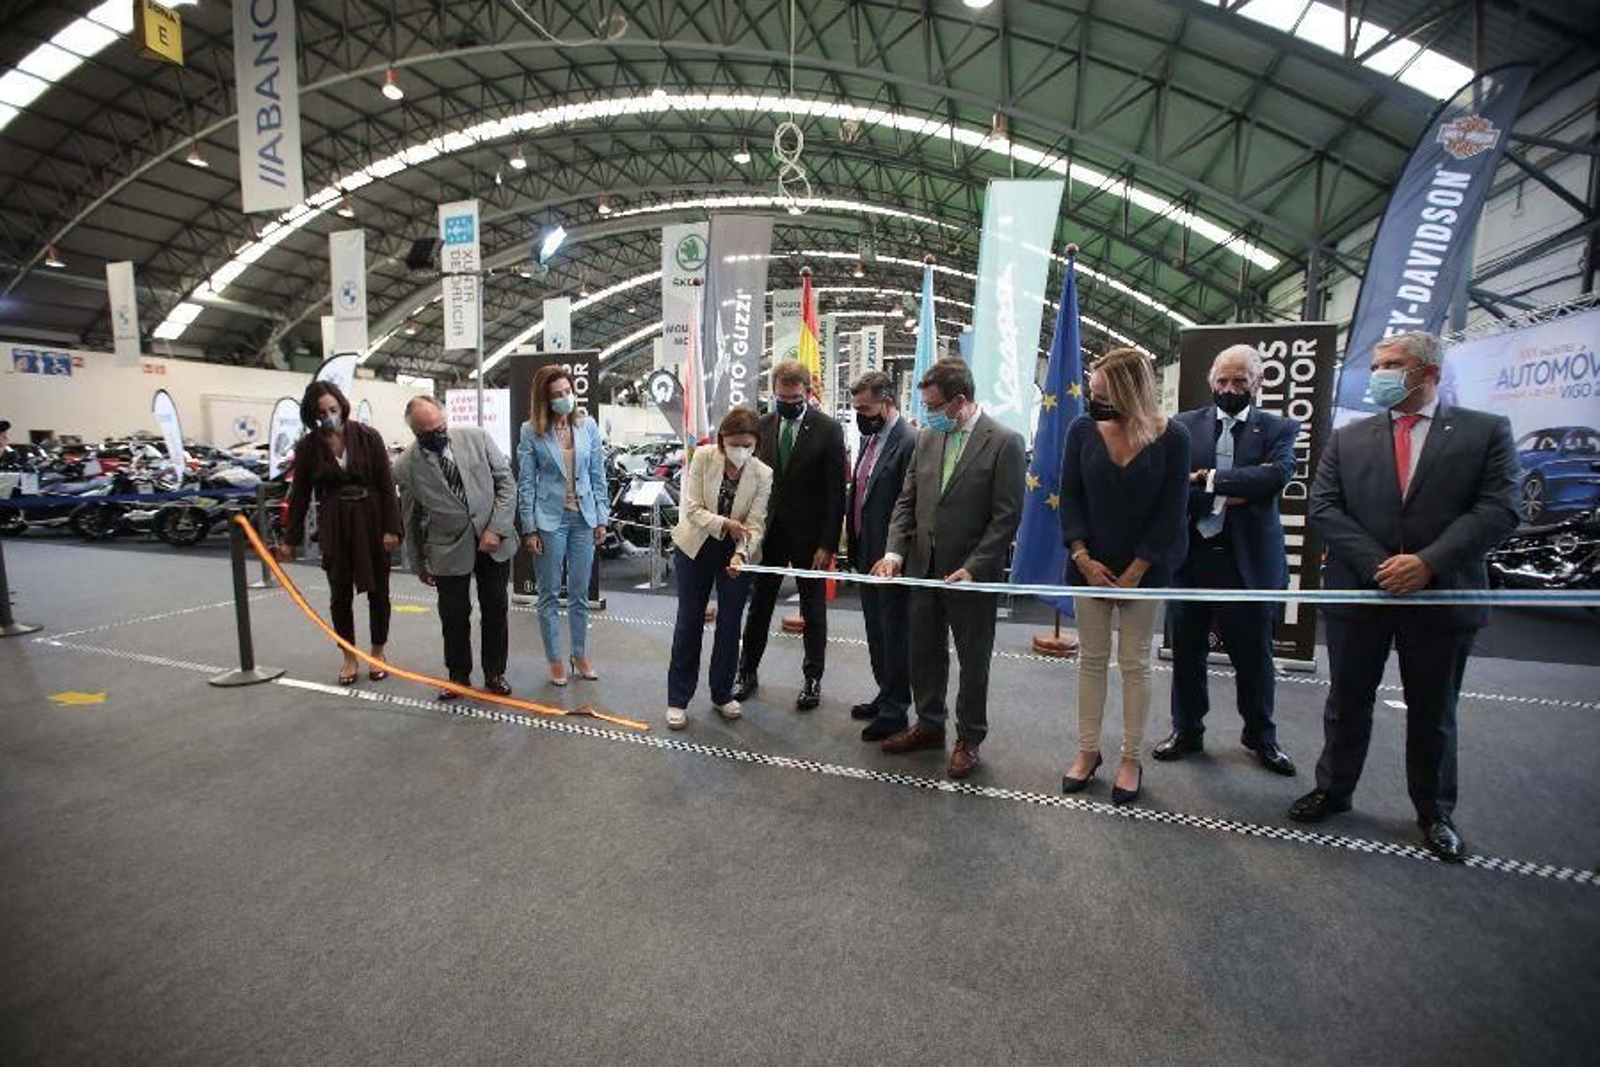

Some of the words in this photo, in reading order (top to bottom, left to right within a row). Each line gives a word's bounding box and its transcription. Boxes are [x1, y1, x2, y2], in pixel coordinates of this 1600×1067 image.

[158, 25, 169, 47] E
[1383, 169, 1472, 342] EY-DAVIDSON
[733, 293, 752, 356] GUZZI
[866, 331, 877, 371] UZUKI
[729, 362, 747, 409] OTO
[1560, 383, 1592, 399] VIGO
